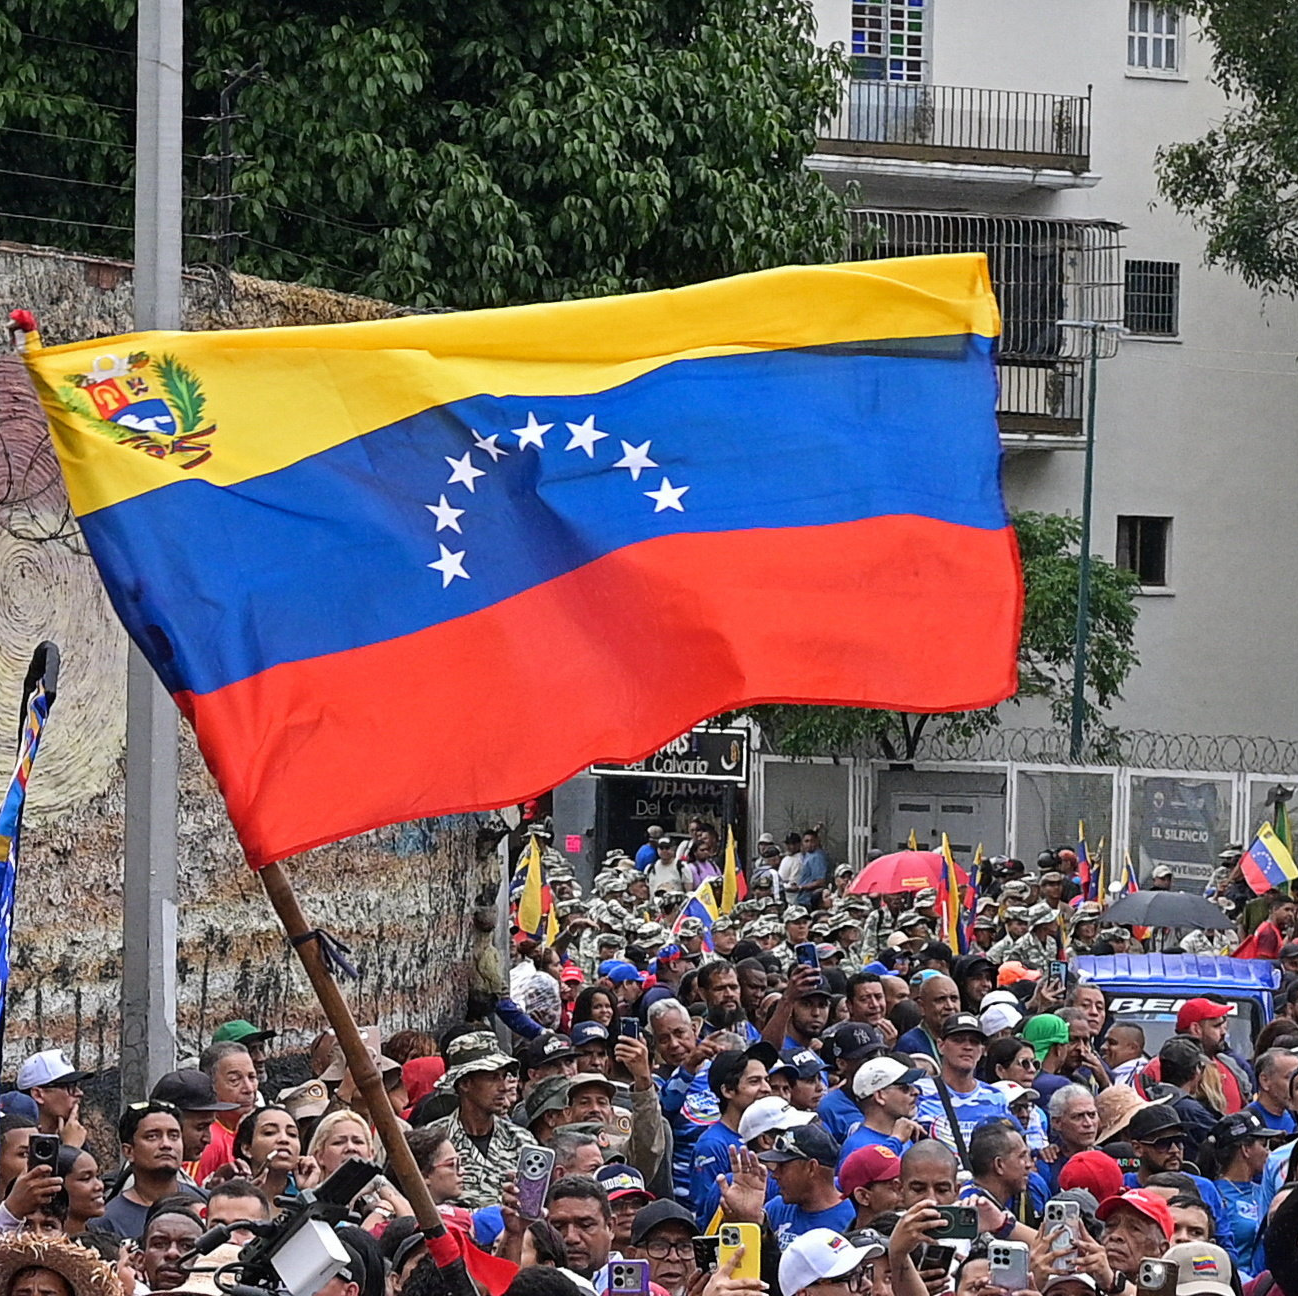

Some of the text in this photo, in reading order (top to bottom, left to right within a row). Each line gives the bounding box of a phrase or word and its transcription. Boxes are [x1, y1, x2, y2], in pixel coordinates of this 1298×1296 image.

[653, 754, 709, 774] Calvario
[1151, 827, 1209, 843] EL SILENCIO
